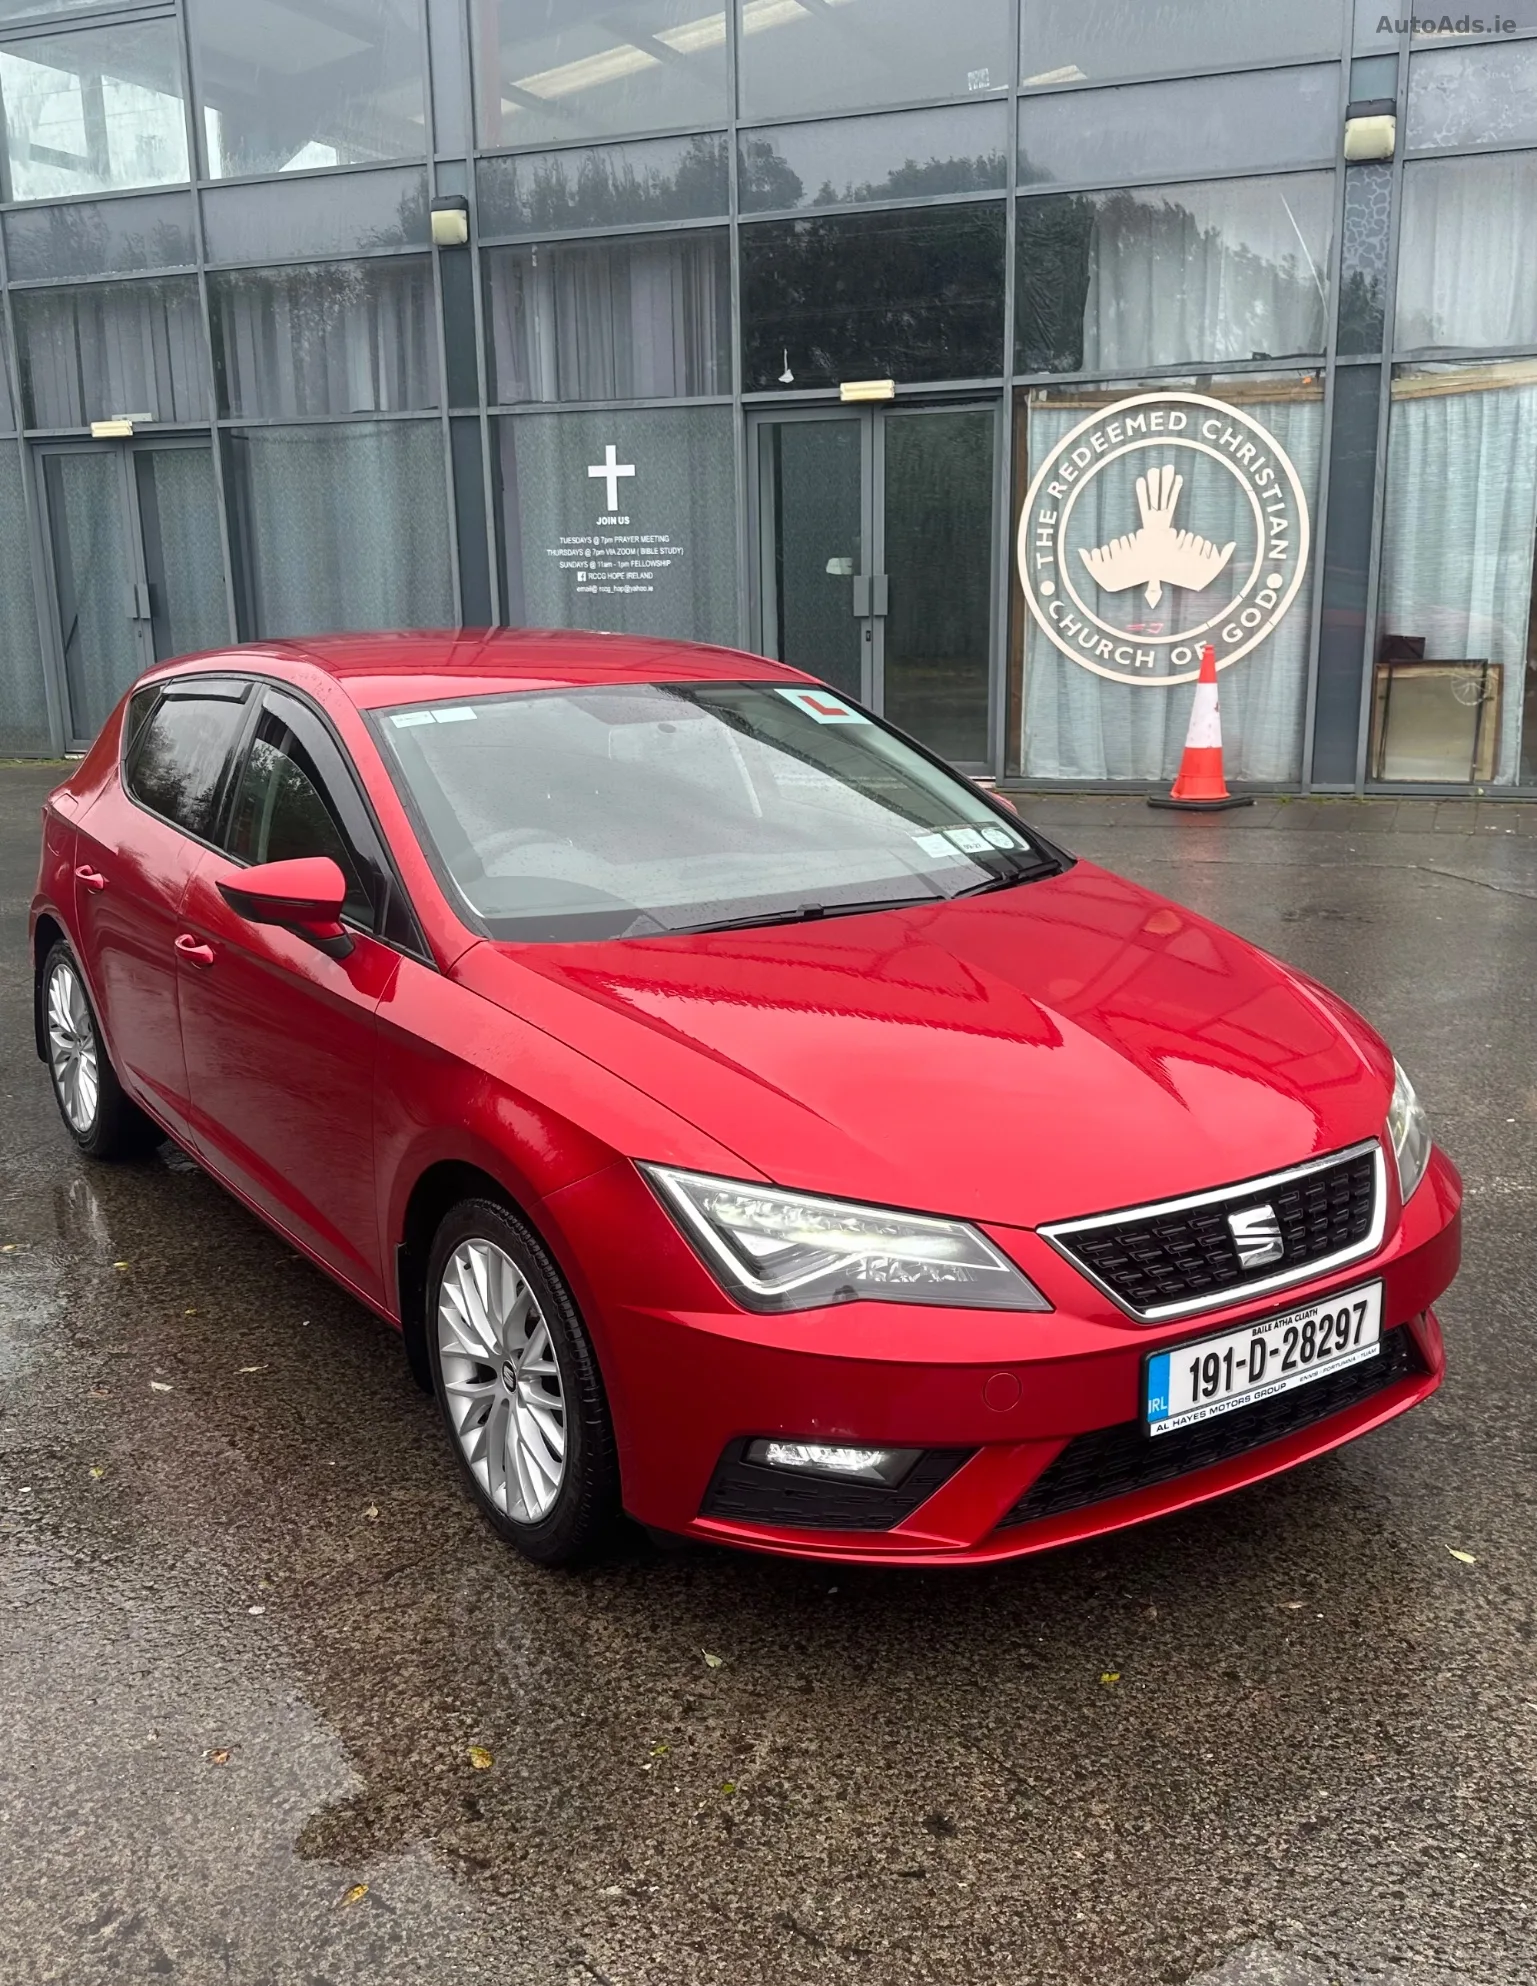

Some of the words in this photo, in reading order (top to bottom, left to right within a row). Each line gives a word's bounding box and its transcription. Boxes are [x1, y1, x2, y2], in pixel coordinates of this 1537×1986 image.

[1036, 508, 1057, 569] THE
[1047, 411, 1187, 499] REDEEMED
[1202, 419, 1289, 560] CHRISTIAN
[596, 516, 617, 525] JOIN
[618, 516, 630, 525] US
[560, 536, 592, 545] TUESDAYS
[593, 536, 600, 546] @
[600, 536, 614, 545] 7pm
[614, 535, 640, 543] PRAYER
[640, 535, 670, 543] MEETING
[547, 548, 584, 557] THURSDAYS
[584, 548, 592, 558] @
[592, 548, 605, 557] 7pm
[605, 548, 617, 556] VIA
[616, 547, 636, 556] ZOOM
[640, 547, 659, 555] BIBLE
[660, 547, 684, 556] STUDY)
[559, 561, 589, 569] SUNDAYS
[589, 560, 597, 570] @
[617, 561, 630, 569] 1pm
[630, 560, 672, 568] FELLOWSHIP
[588, 572, 607, 580] RCCG
[607, 572, 625, 580] HOPE
[625, 571, 654, 580] IRELAND
[1048, 600, 1155, 668] CHURCH
[1171, 640, 1209, 666] OF
[1222, 588, 1278, 644] GOD
[797, 695, 850, 716] L
[1252, 1324, 1273, 1337] BAILE
[1295, 1308, 1318, 1323] CLIATH
[1189, 1299, 1369, 1402] 191-D-28297
[1148, 1395, 1168, 1414] IRL
[1156, 1423, 1170, 1432] AL
[1172, 1410, 1207, 1428] HAYES
[1209, 1396, 1251, 1415] MOTORS
[1254, 1382, 1287, 1400] GROUP
